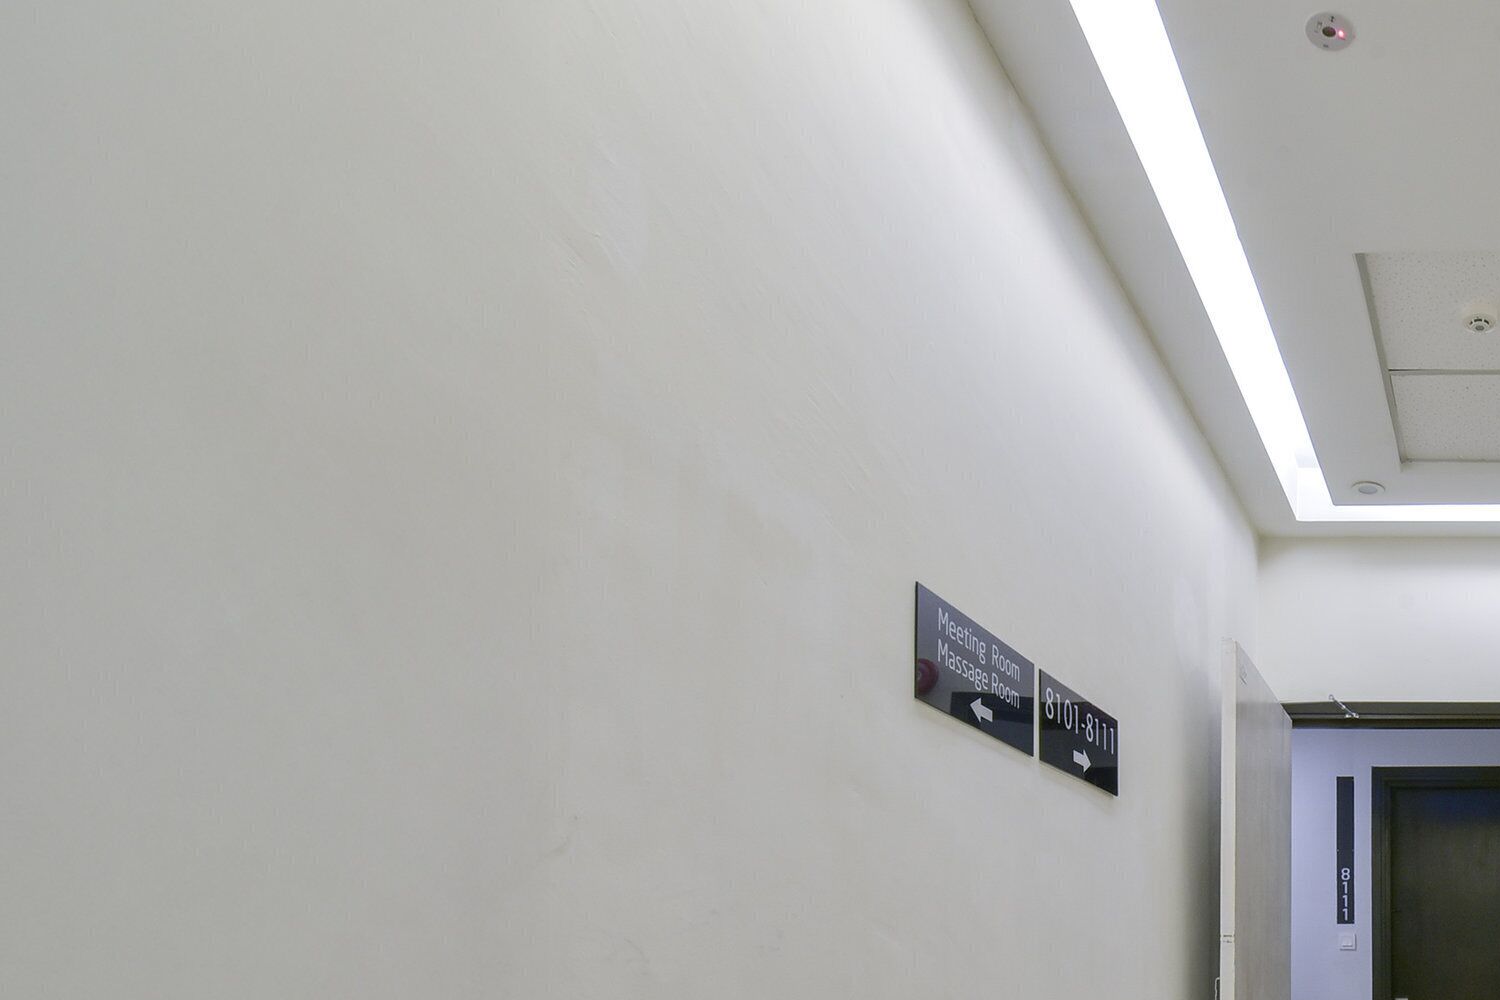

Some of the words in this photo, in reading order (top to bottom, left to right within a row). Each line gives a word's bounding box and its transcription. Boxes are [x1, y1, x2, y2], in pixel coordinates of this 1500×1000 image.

[937, 638, 989, 691] Massage
[991, 672, 1020, 709] Room
[938, 607, 986, 664] Meeting
[991, 644, 1020, 682] Room
[1045, 687, 1115, 755] 8101-8111
[1341, 867, 1350, 921] 8111
